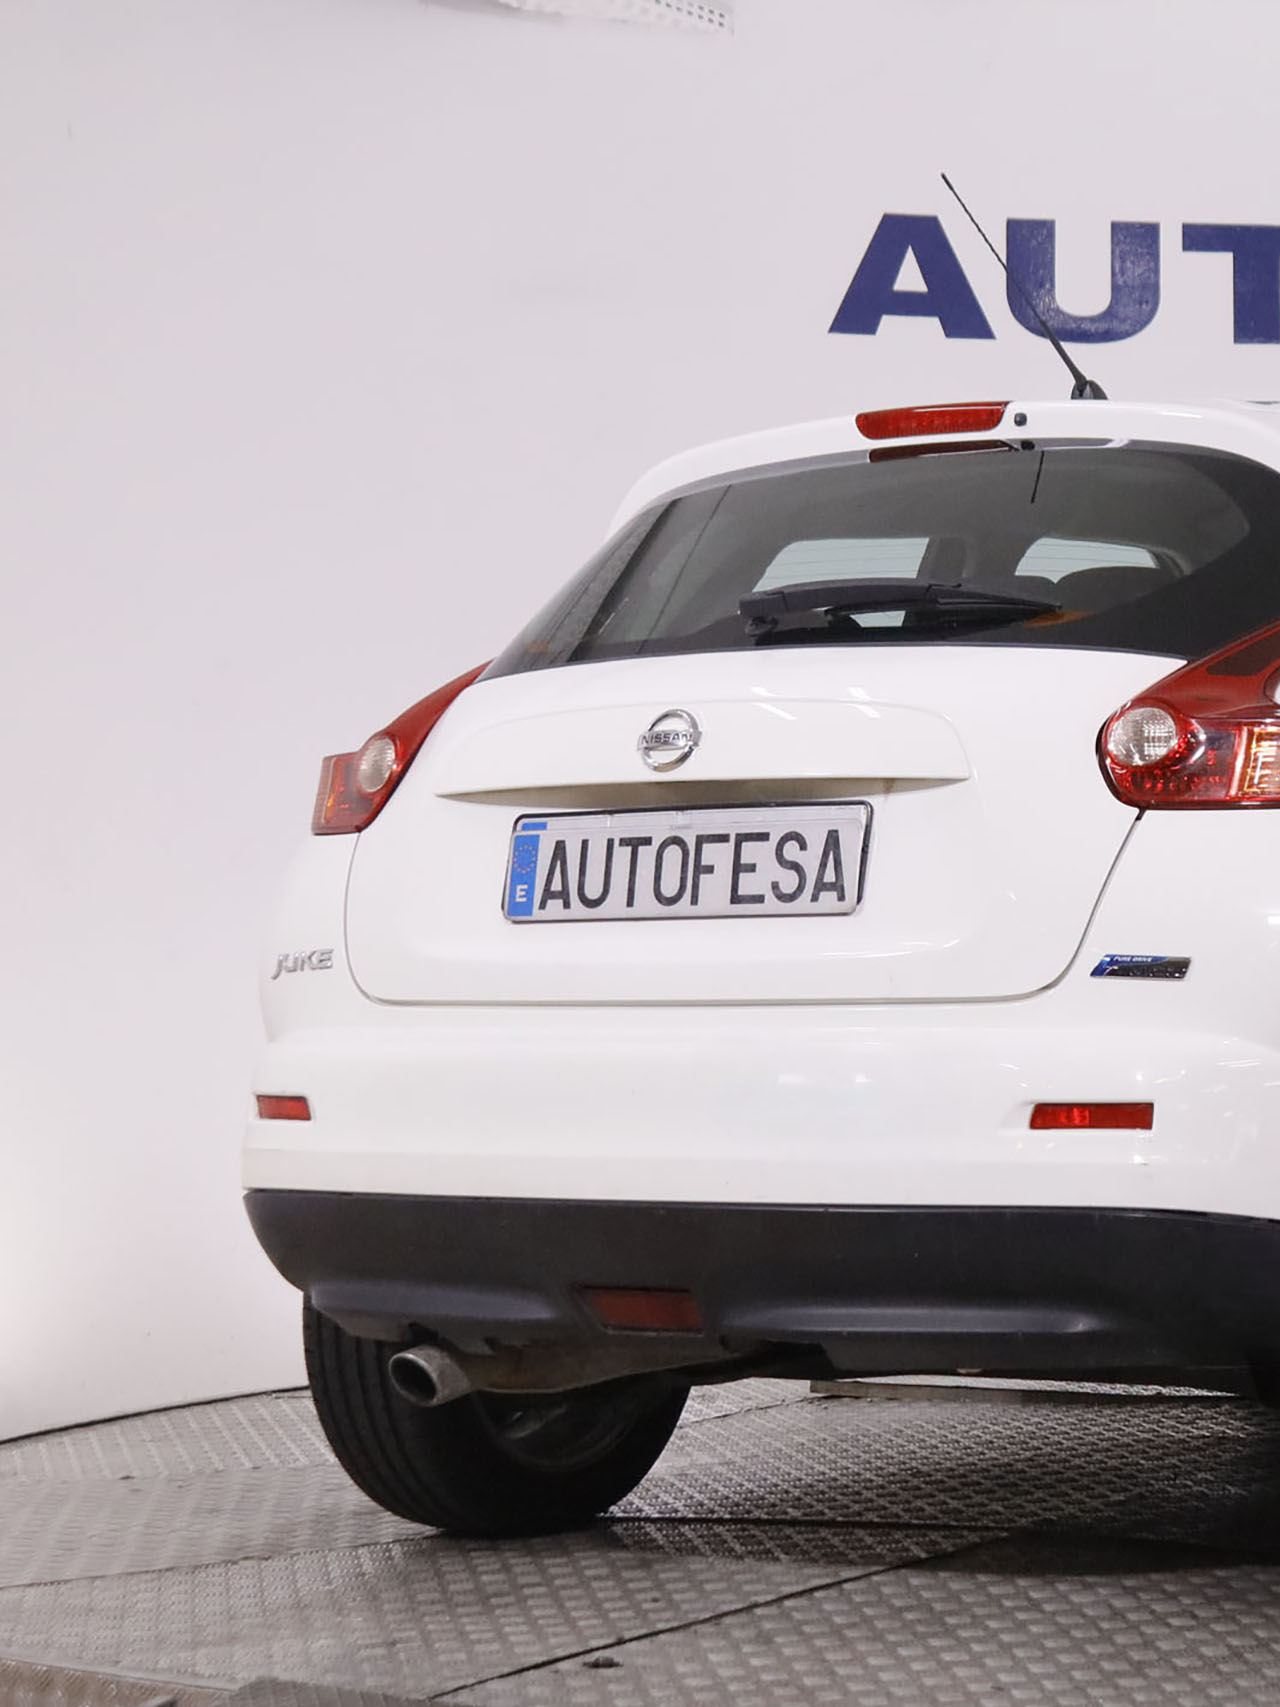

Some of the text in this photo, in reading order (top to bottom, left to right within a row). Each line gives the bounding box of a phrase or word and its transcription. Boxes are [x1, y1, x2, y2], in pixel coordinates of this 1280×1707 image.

[641, 732, 693, 745] NISSAN
[538, 829, 846, 911] AUTOFESA
[514, 883, 528, 902] E
[271, 948, 334, 980] JUKE
